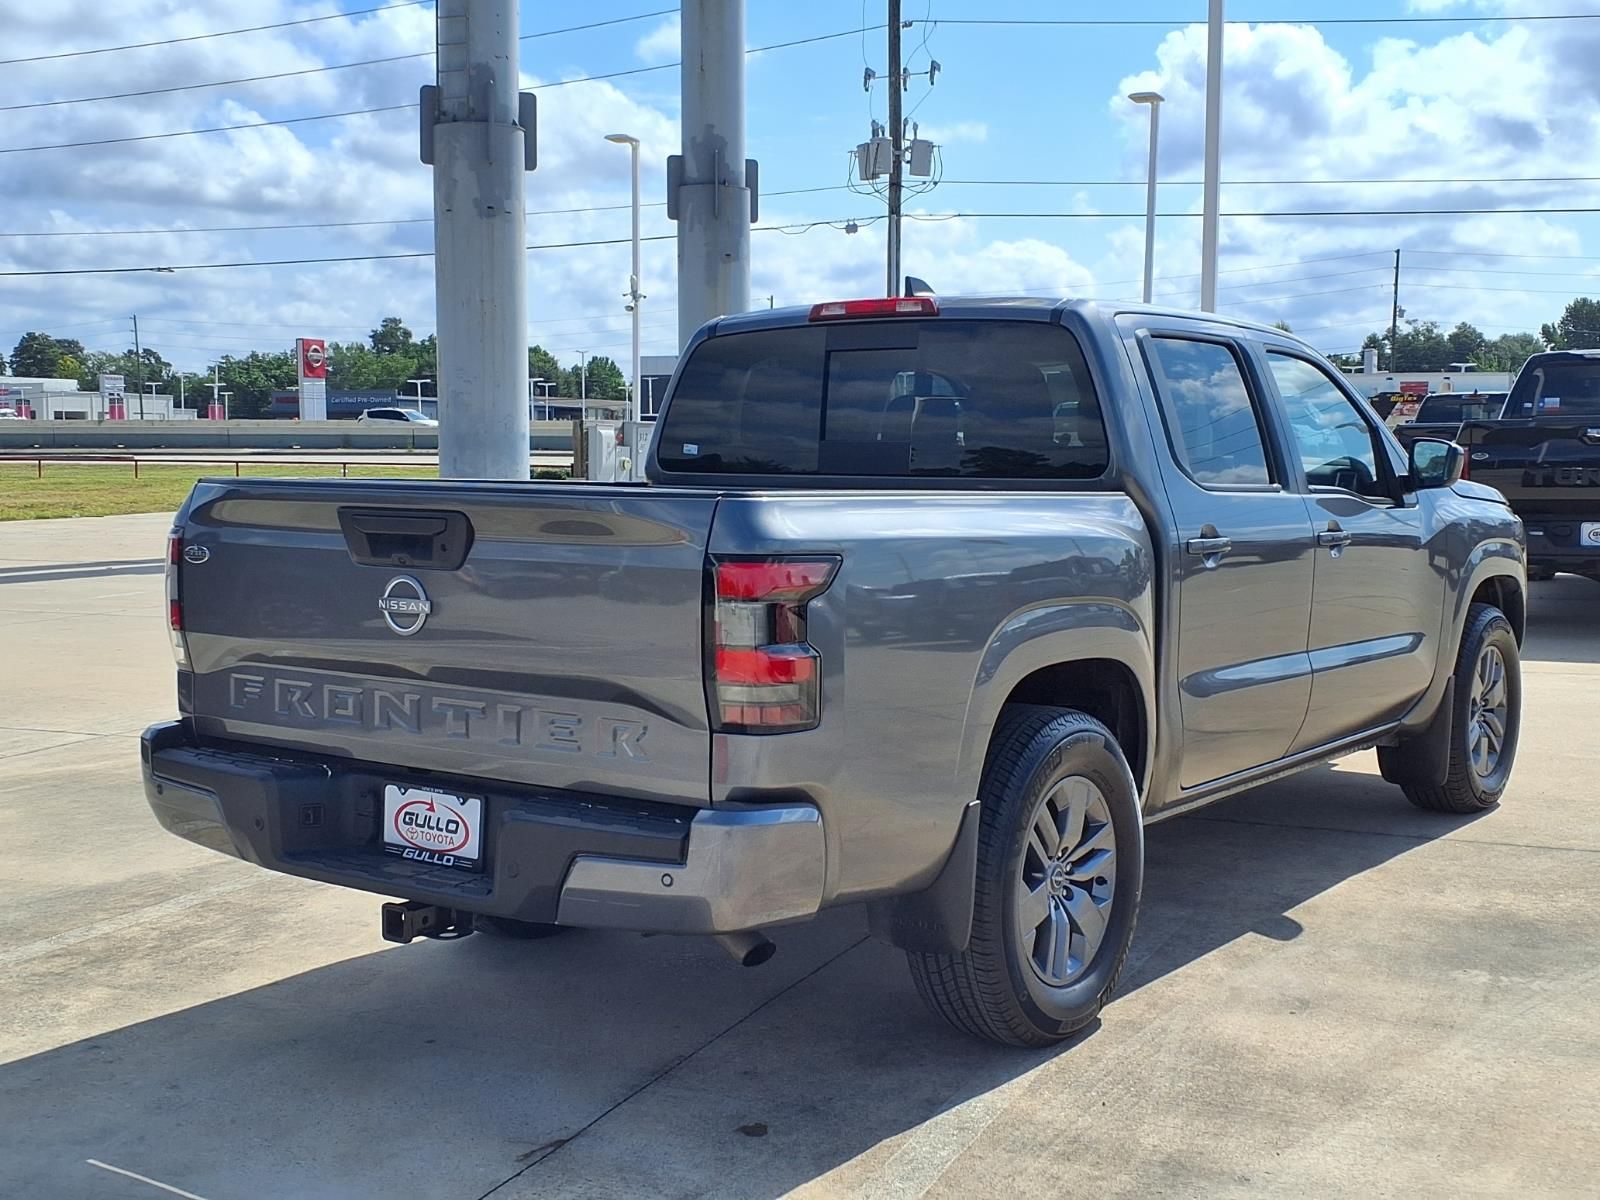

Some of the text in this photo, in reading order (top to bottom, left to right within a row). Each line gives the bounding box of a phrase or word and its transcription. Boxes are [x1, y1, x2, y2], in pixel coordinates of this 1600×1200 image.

[378, 599, 429, 612] NISSAN
[229, 673, 650, 763] FRONTIER
[402, 811, 460, 835] GULLO
[420, 831, 455, 847] TOYOTA
[402, 848, 455, 866] GULLO
